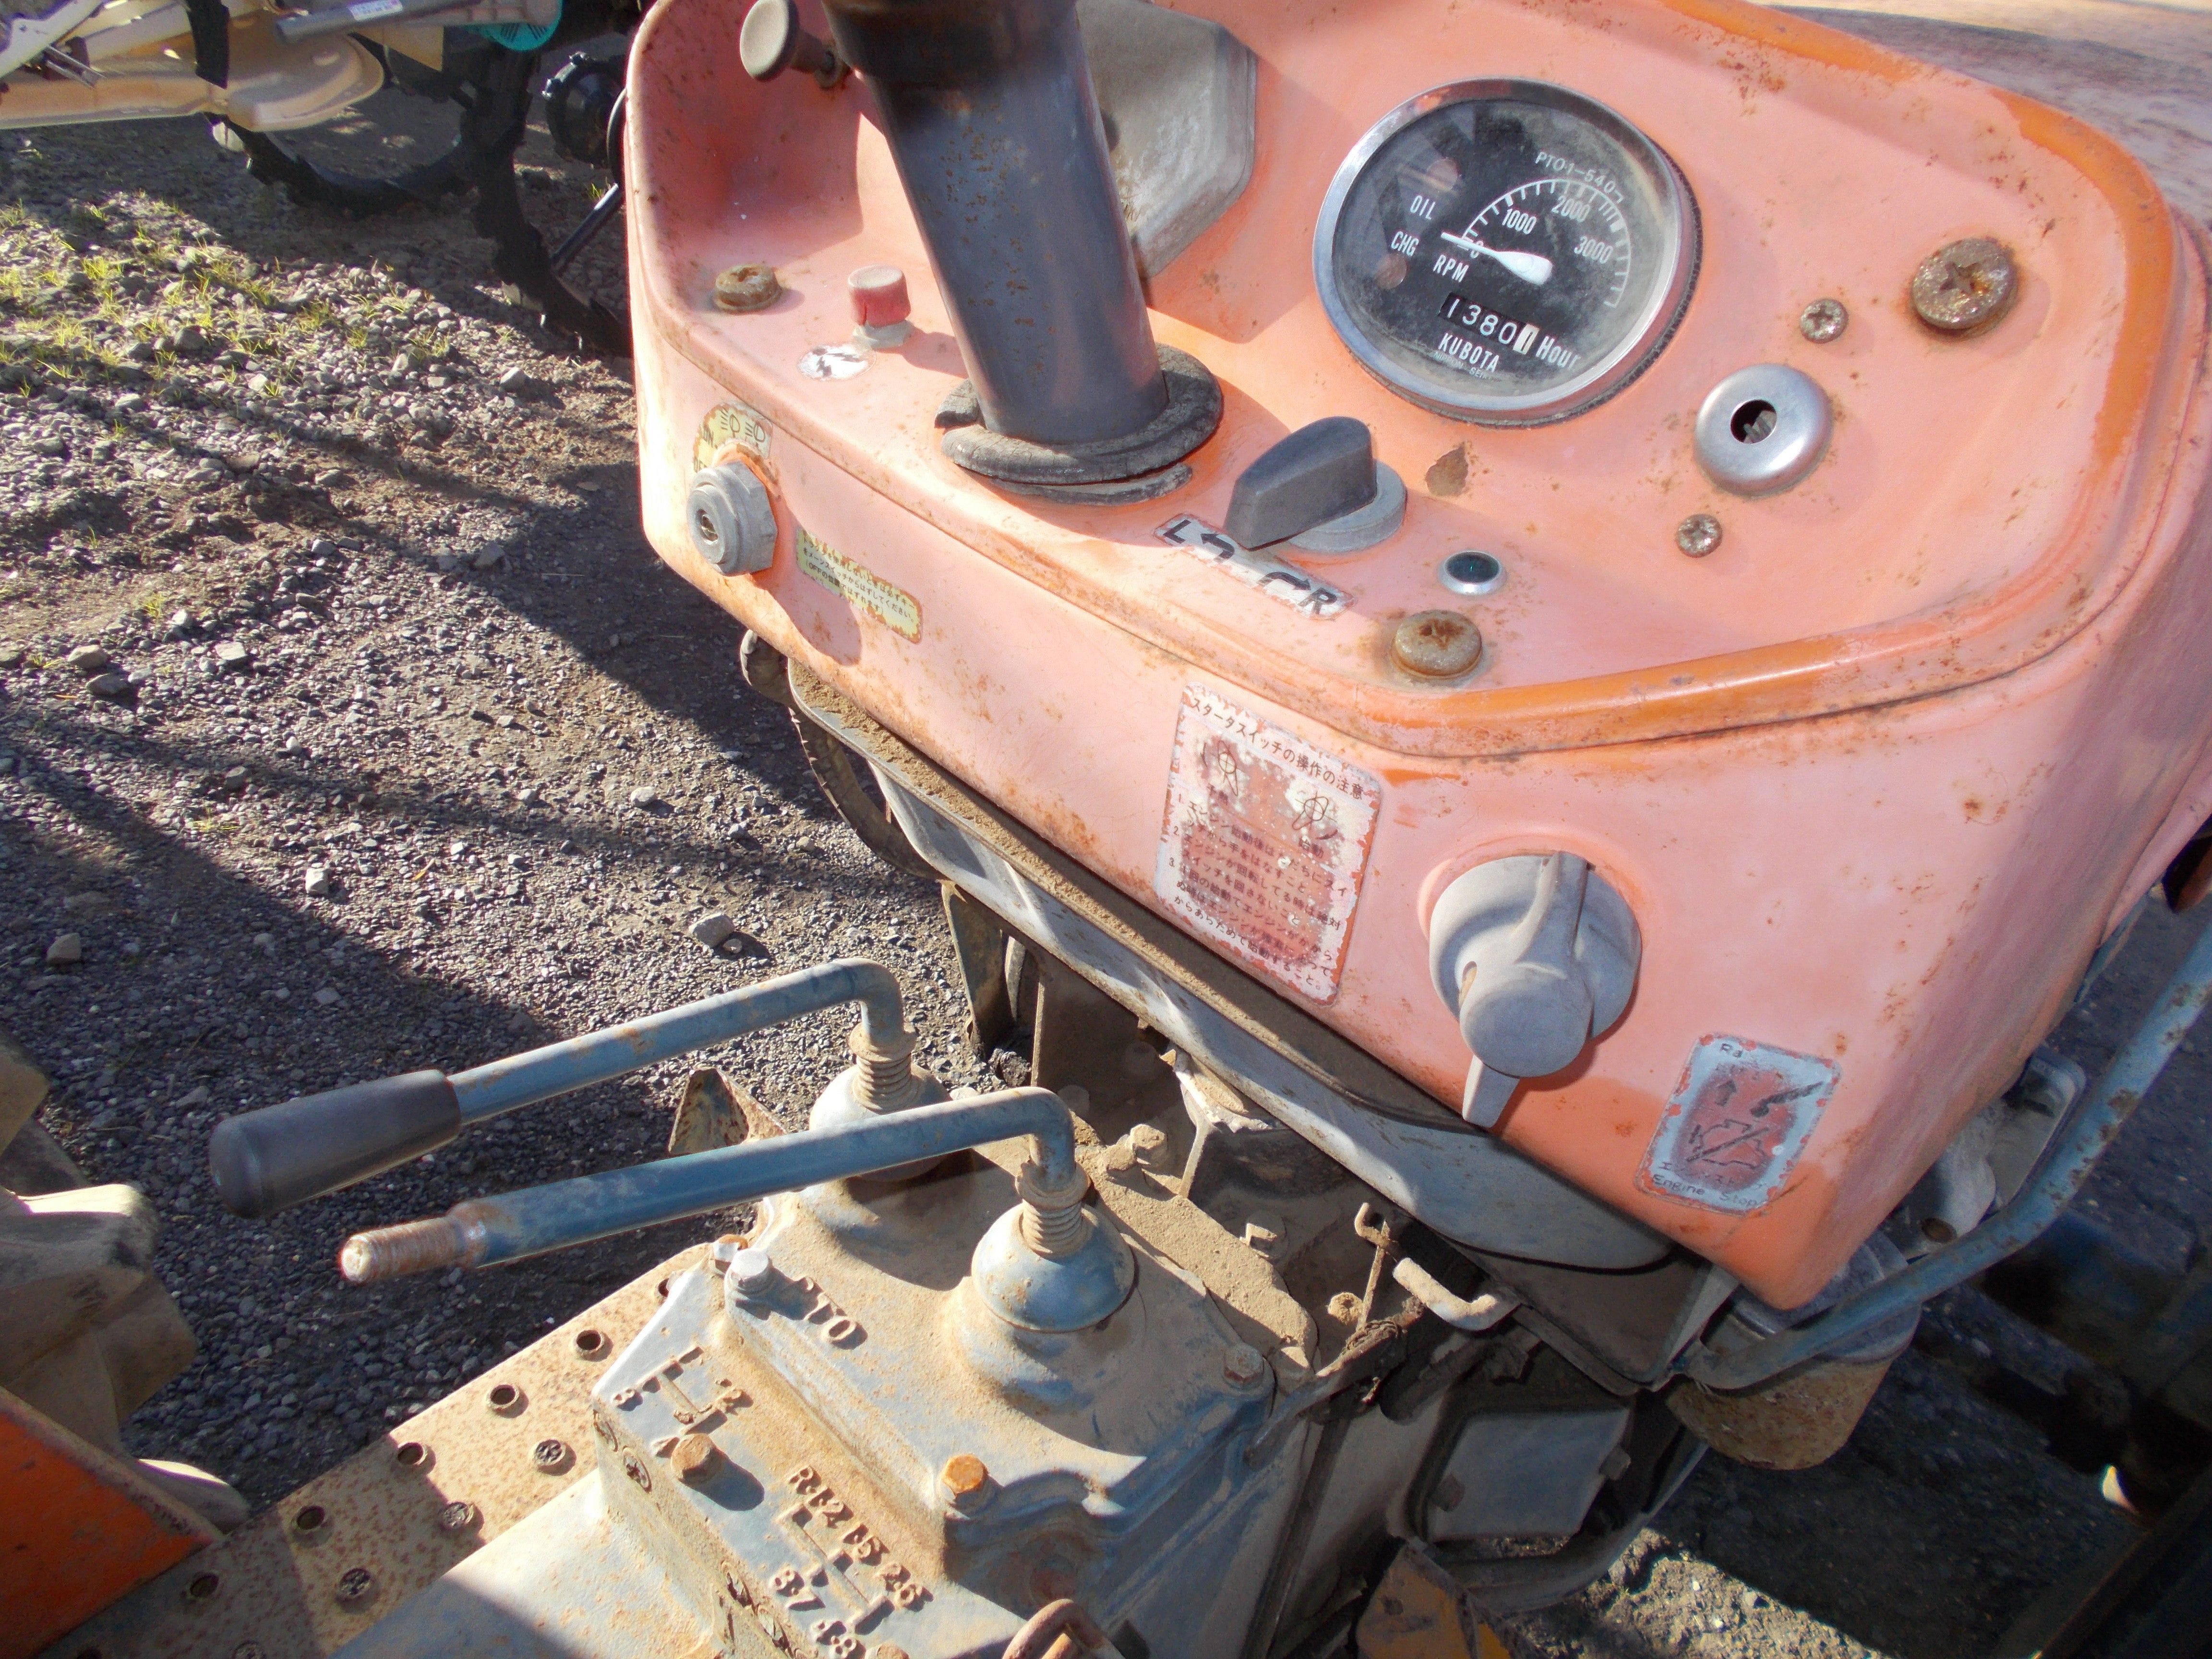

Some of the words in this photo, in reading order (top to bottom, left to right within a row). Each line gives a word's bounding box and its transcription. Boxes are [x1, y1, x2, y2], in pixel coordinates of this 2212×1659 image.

[1409, 195, 1436, 220] OIL
[1502, 208, 1538, 234] 1000
[1551, 195, 1591, 222] 2000
[1391, 231, 1419, 257] CHG
[1574, 236, 1613, 263] 3000
[1432, 254, 1469, 283] RPM
[1438, 333, 1500, 373] KUBOTA
[1536, 336, 1582, 371] Hour
[1163, 519, 1191, 543] L
[1299, 587, 1338, 614] R
